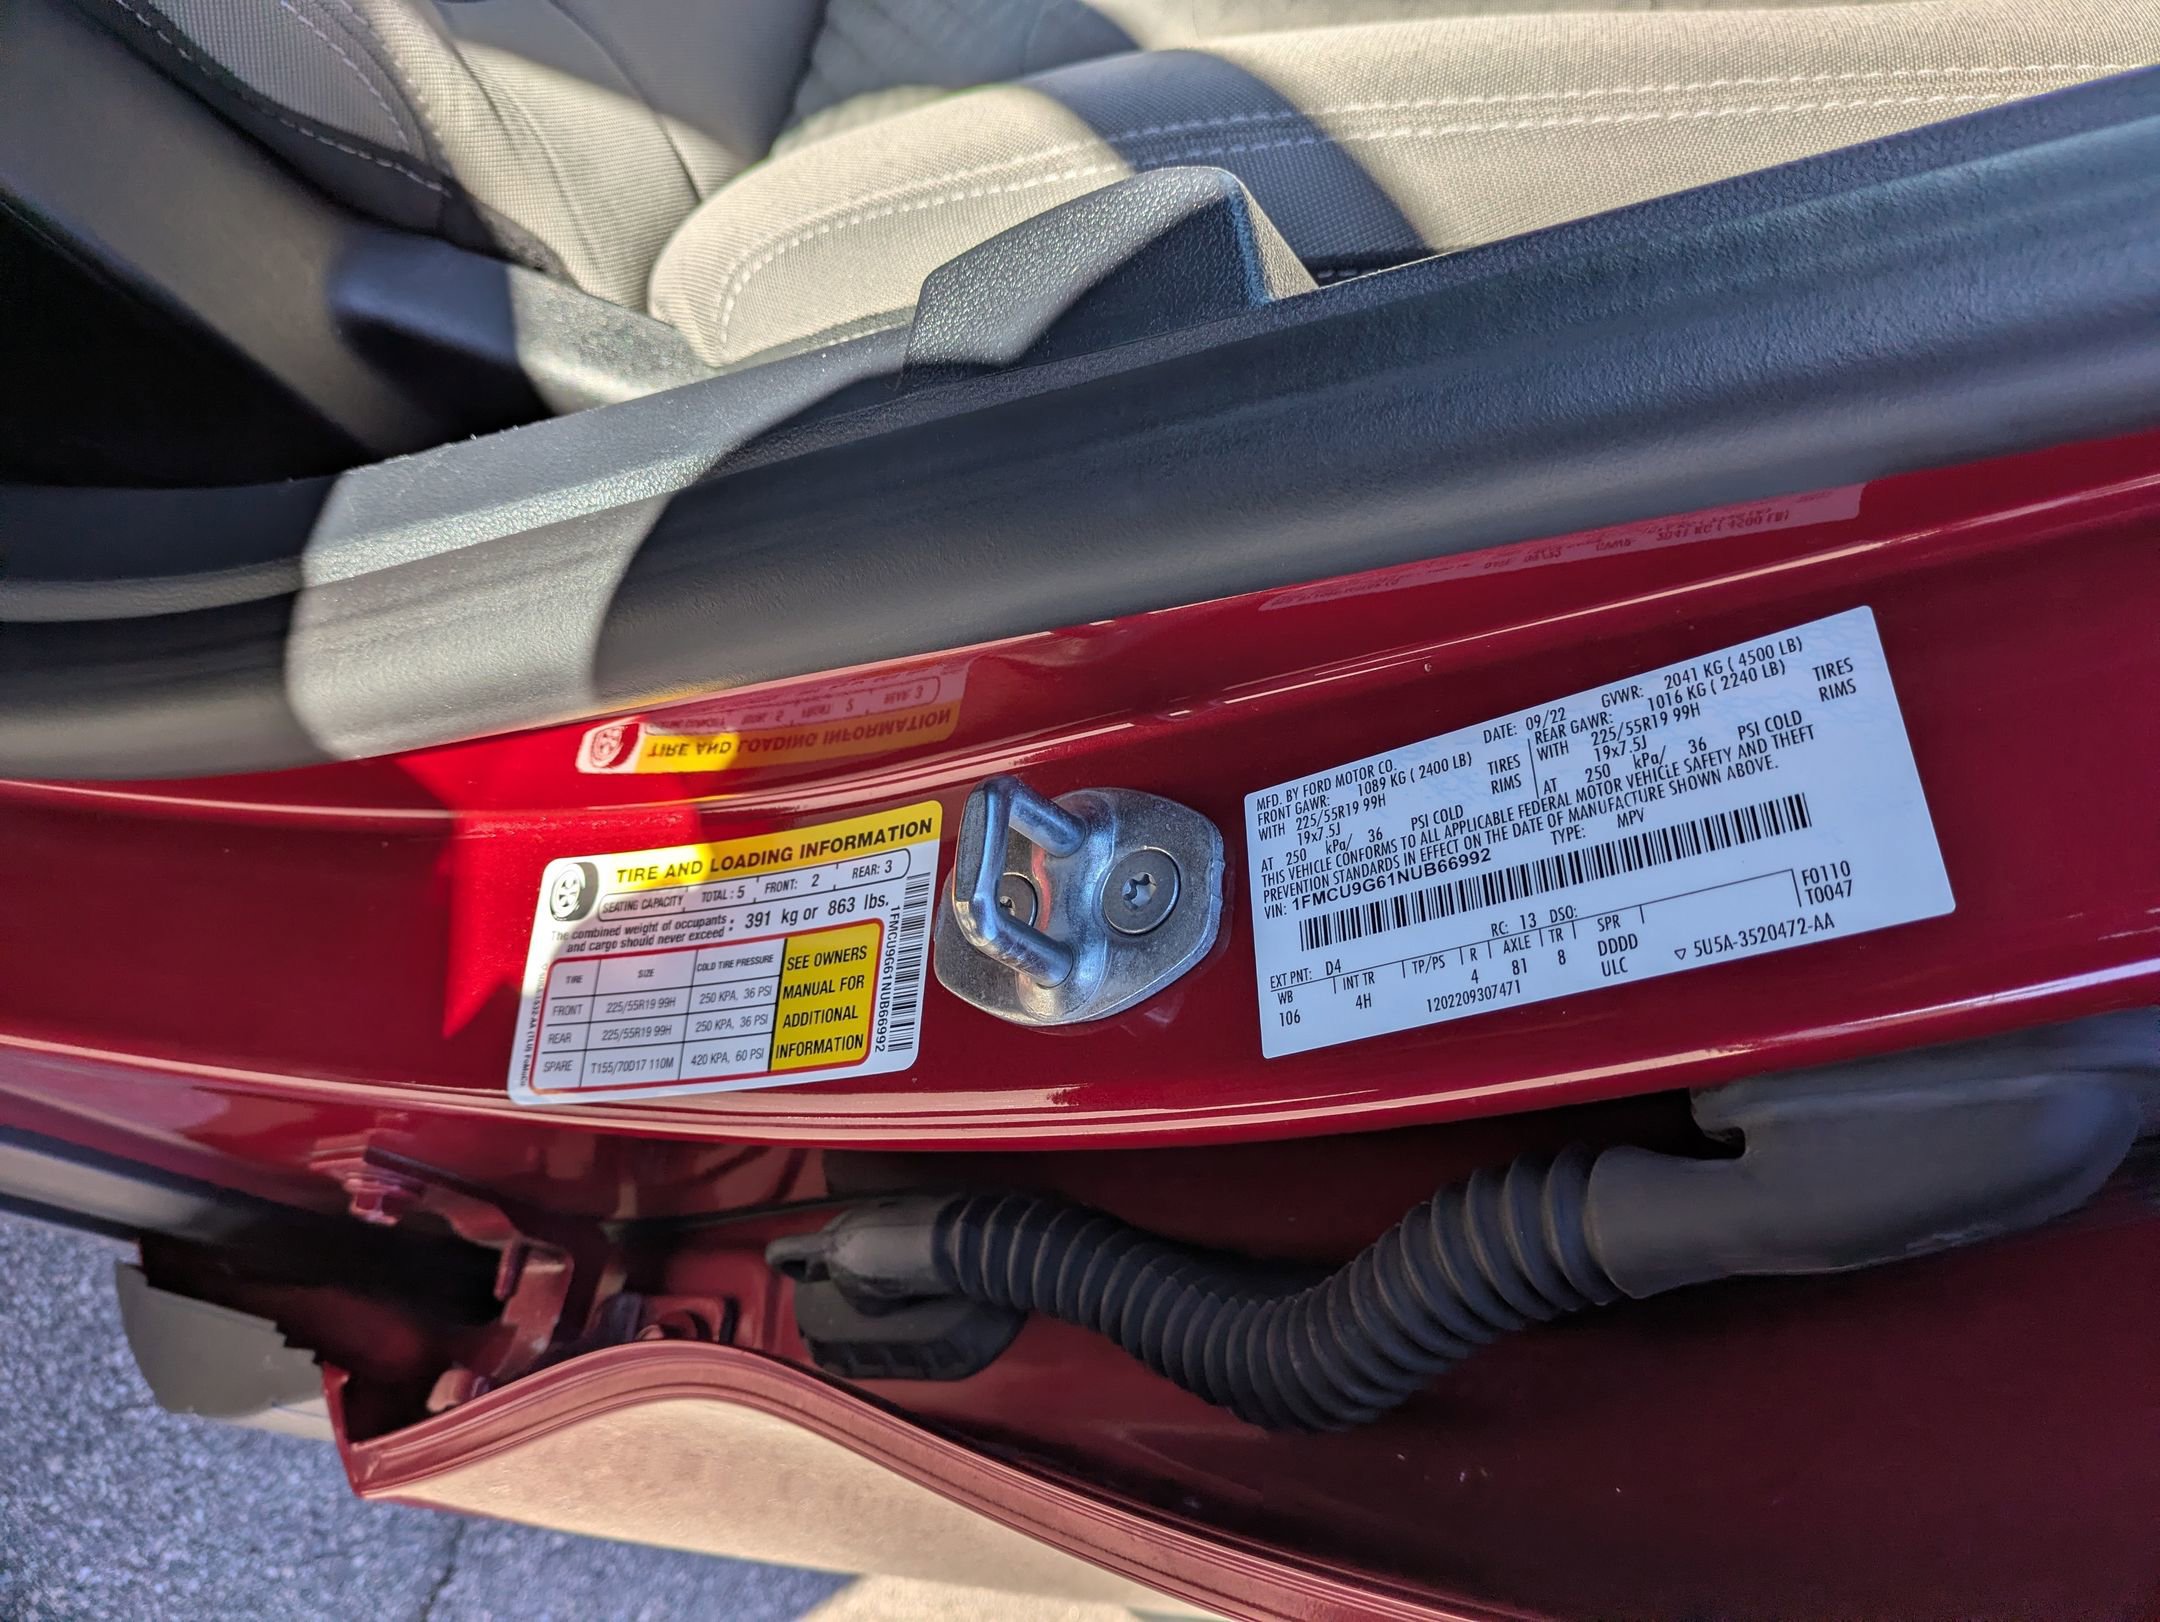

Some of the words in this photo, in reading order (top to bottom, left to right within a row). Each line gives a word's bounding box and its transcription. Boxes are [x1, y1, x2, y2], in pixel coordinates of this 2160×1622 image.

[1601, 684, 1643, 707] GVWR:
[1663, 667, 1697, 689] 2041
[1703, 659, 1722, 677] KG
[1738, 644, 1774, 666] 4500
[1778, 635, 1802, 655] LB)
[1812, 657, 1853, 681] TIRES
[1534, 723, 1566, 744] REAR
[1569, 711, 1613, 734] GAWR:
[1647, 689, 1682, 711] 1016
[1686, 682, 1706, 700] KG
[1720, 667, 1757, 690] 2240
[1761, 658, 1785, 678] LB)
[1818, 678, 1856, 702] RIMS
[1482, 722, 1517, 743] DATE:
[1525, 706, 1566, 730] 09/22
[1536, 739, 1569, 760] WITH
[1590, 711, 1667, 746] 225/55R19
[1672, 701, 1700, 722] 99H
[1584, 763, 1610, 783] 250
[1632, 745, 1665, 769] kPa/
[1687, 736, 1706, 754] 36
[1737, 721, 1760, 740] PSI
[1764, 710, 1802, 732] COLD
[1593, 734, 1646, 762] 19x7.5J
[1487, 753, 1520, 775] TIRES
[1256, 793, 1282, 811] MFD.
[1285, 786, 1298, 802] BY
[1302, 777, 1331, 797] FORD
[1335, 764, 1374, 788] MOTOR
[1378, 758, 1396, 774] CO.
[1257, 804, 1290, 826] FRONT
[1294, 794, 1329, 814] GAWR:
[1357, 776, 1386, 796] 1089
[1390, 770, 1406, 787] KG
[1418, 758, 1448, 779] 2400
[1452, 751, 1471, 769] LB)
[1490, 773, 1521, 794] RIMS
[1258, 822, 1285, 841] WITH
[1295, 800, 1359, 831] 225/55R19
[1362, 792, 1385, 811] 99H
[1261, 869, 1285, 887] THIS
[1288, 856, 1332, 880] VEHICLE
[1335, 838, 1397, 867] CONFORMS
[1400, 833, 1416, 850] TO
[1420, 827, 1440, 845] ALL
[1444, 806, 1514, 839] APPLICABLE
[1517, 791, 1571, 818] FEDERAL
[1575, 777, 1623, 803] MOTOR
[1683, 746, 1730, 773] SAFETY
[1738, 737, 1767, 759] AND
[1770, 724, 1813, 749] THEFT
[1263, 873, 1329, 903] PREVENTION
[1332, 854, 1400, 885] STANDARDS
[1403, 850, 1416, 866] IN
[1420, 838, 1458, 862] EFFECT
[1463, 832, 1481, 850] ON
[1484, 825, 1508, 844] THE
[1511, 816, 1543, 837] DATE
[1546, 810, 1563, 827] OF
[1568, 783, 1665, 822] MANUFACTURE
[1668, 768, 1721, 795] SHOWN
[1727, 754, 1778, 780] ABOVE.
[1285, 847, 1306, 865] 250
[1325, 833, 1352, 854] kPa/
[1367, 826, 1383, 842] 36
[1410, 813, 1428, 831] PSI
[1432, 804, 1463, 824] COLD
[1297, 821, 1340, 845] 19x7.5J
[1550, 823, 1585, 845] TYPE:
[1616, 807, 1643, 828] MPV
[617, 865, 658, 882] TIRE
[663, 860, 703, 878] AND
[710, 846, 792, 872] LOADING
[799, 817, 932, 859] INFORMATION
[851, 863, 880, 879] REAR:
[884, 859, 892, 873] 3
[1801, 860, 1850, 886] F0110
[736, 885, 745, 898] 5
[764, 878, 797, 893] FRONT:
[811, 873, 819, 887] 2
[1263, 902, 1286, 919] VIN:
[1292, 847, 1491, 910] 1FMCU9G61NUB66992
[1804, 879, 1851, 904] T0047
[602, 899, 638, 913] SEATING
[640, 895, 683, 910] CAPACITY
[744, 910, 770, 928] 391
[780, 908, 798, 925] kg
[802, 906, 818, 920] or
[827, 896, 855, 915] 863
[863, 893, 888, 910] lbs.
[1549, 904, 1577, 923] DSO:
[570, 925, 621, 939] combined
[624, 922, 658, 935] weight
[661, 919, 672, 931] of
[674, 914, 726, 929] occupants
[1490, 920, 1508, 936] RC:
[1519, 912, 1536, 929] 13
[1547, 927, 1563, 942] TR
[1596, 914, 1620, 932] SPR
[1693, 912, 1834, 957] 5U5A-3520472-AA
[565, 940, 586, 952] and
[588, 940, 617, 952] cargo
[619, 934, 654, 948] should
[657, 933, 685, 944] never
[688, 925, 724, 941] exceed
[1503, 934, 1531, 954] AXLE
[1597, 933, 1637, 956] DDDD
[786, 954, 809, 970] SEE
[813, 945, 867, 966] OWNERS
[1411, 954, 1445, 974] TP/PS
[1511, 957, 1526, 975] 81
[1600, 956, 1627, 976] ULC
[874, 905, 900, 1052] 1FMCU9G61NUB66992
[1269, 972, 1287, 988] EXT
[1290, 967, 1312, 984] PNT:
[1325, 958, 1341, 976] D4
[1342, 974, 1359, 990] INT
[1361, 970, 1374, 985] TR
[698, 991, 716, 1004] 250
[718, 989, 737, 1001] KPA,
[743, 987, 755, 999] 36
[757, 985, 772, 997] PSI
[782, 979, 835, 999] MANUAL
[839, 974, 864, 991] FOR
[1277, 989, 1293, 1004] WB
[1426, 979, 1520, 1012] 1202209307471
[552, 1003, 582, 1015] FRONT
[605, 998, 656, 1013] 225/55R19
[658, 997, 675, 1008] 99H
[1355, 992, 1371, 1009] 4H
[695, 1019, 712, 1032] 250
[714, 1017, 734, 1030] KPA,
[739, 1015, 751, 1027] 36
[753, 1013, 768, 1025] PSI
[782, 1004, 858, 1028] ADDITIONAL
[1279, 1008, 1300, 1026] 106
[547, 1032, 571, 1044] REAR
[601, 1025, 652, 1041] 225/55R19
[653, 1024, 672, 1036] 99H
[690, 1053, 708, 1065] 420
[709, 1051, 729, 1063] KPA,
[735, 1049, 747, 1061] 60
[749, 1047, 764, 1059] PSI
[775, 1033, 863, 1058] INFORMATION
[543, 1059, 573, 1072] SPARE
[591, 1058, 647, 1074] T155/70D17
[650, 1056, 674, 1069] 110M
